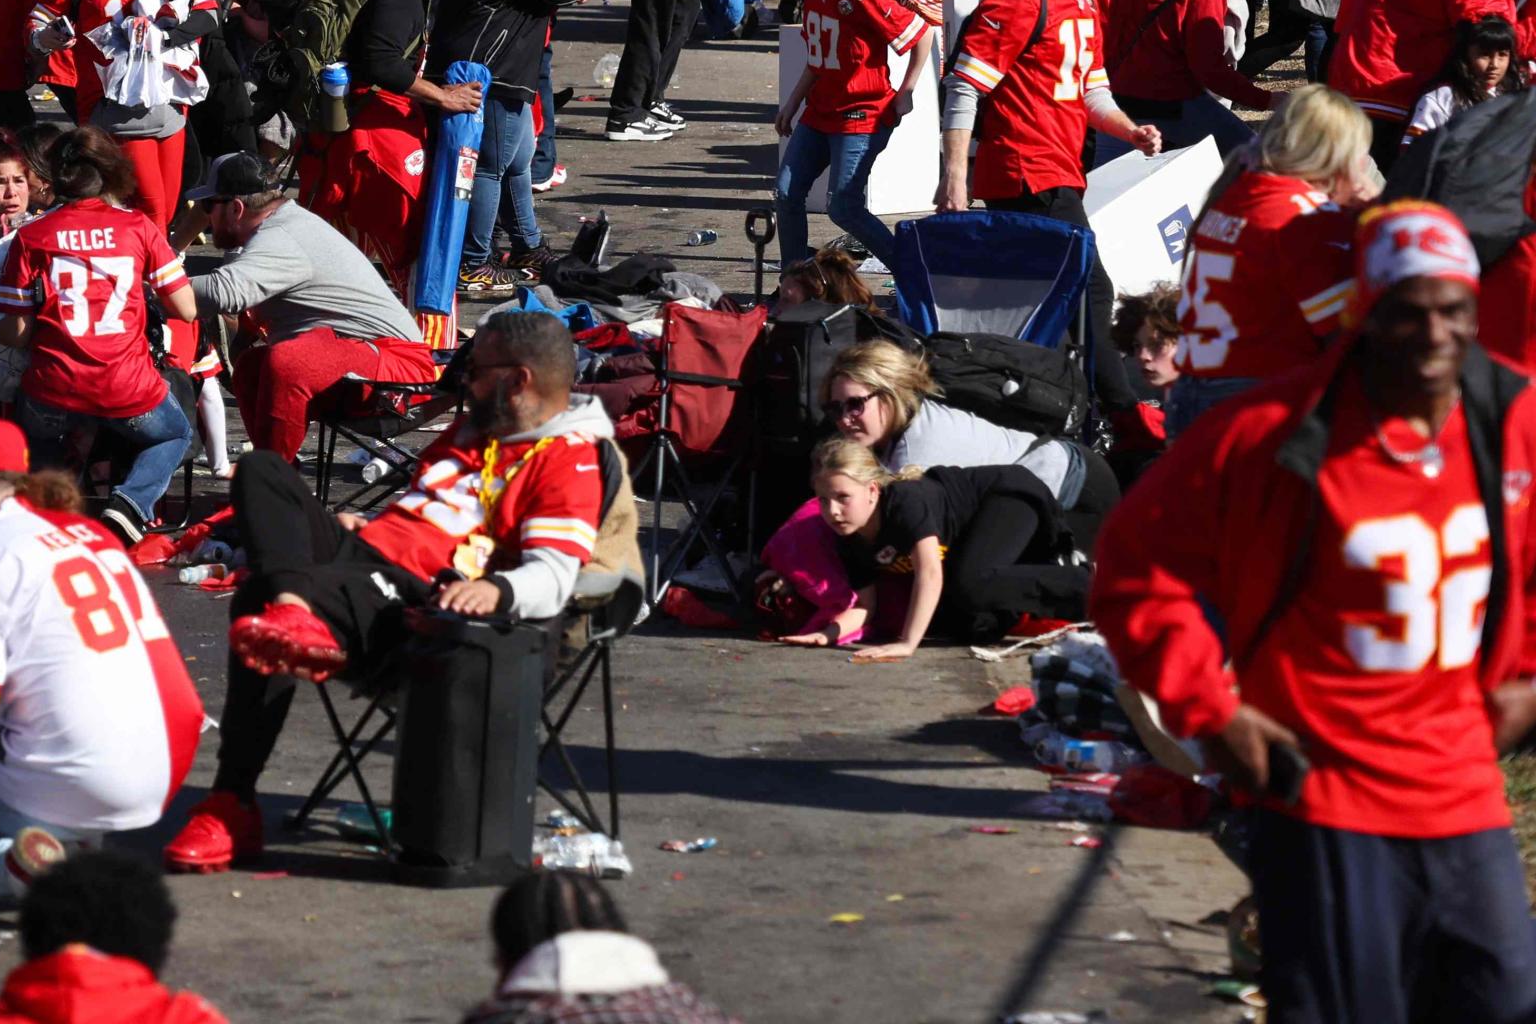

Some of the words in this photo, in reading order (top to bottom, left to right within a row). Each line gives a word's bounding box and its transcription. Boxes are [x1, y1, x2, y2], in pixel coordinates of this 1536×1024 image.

[806, 9, 840, 70] 87
[56, 227, 117, 252] KELCE
[51, 256, 135, 337] 87
[35, 523, 104, 552] KELCE
[52, 548, 170, 653] 87
[1343, 502, 1493, 673] 32
